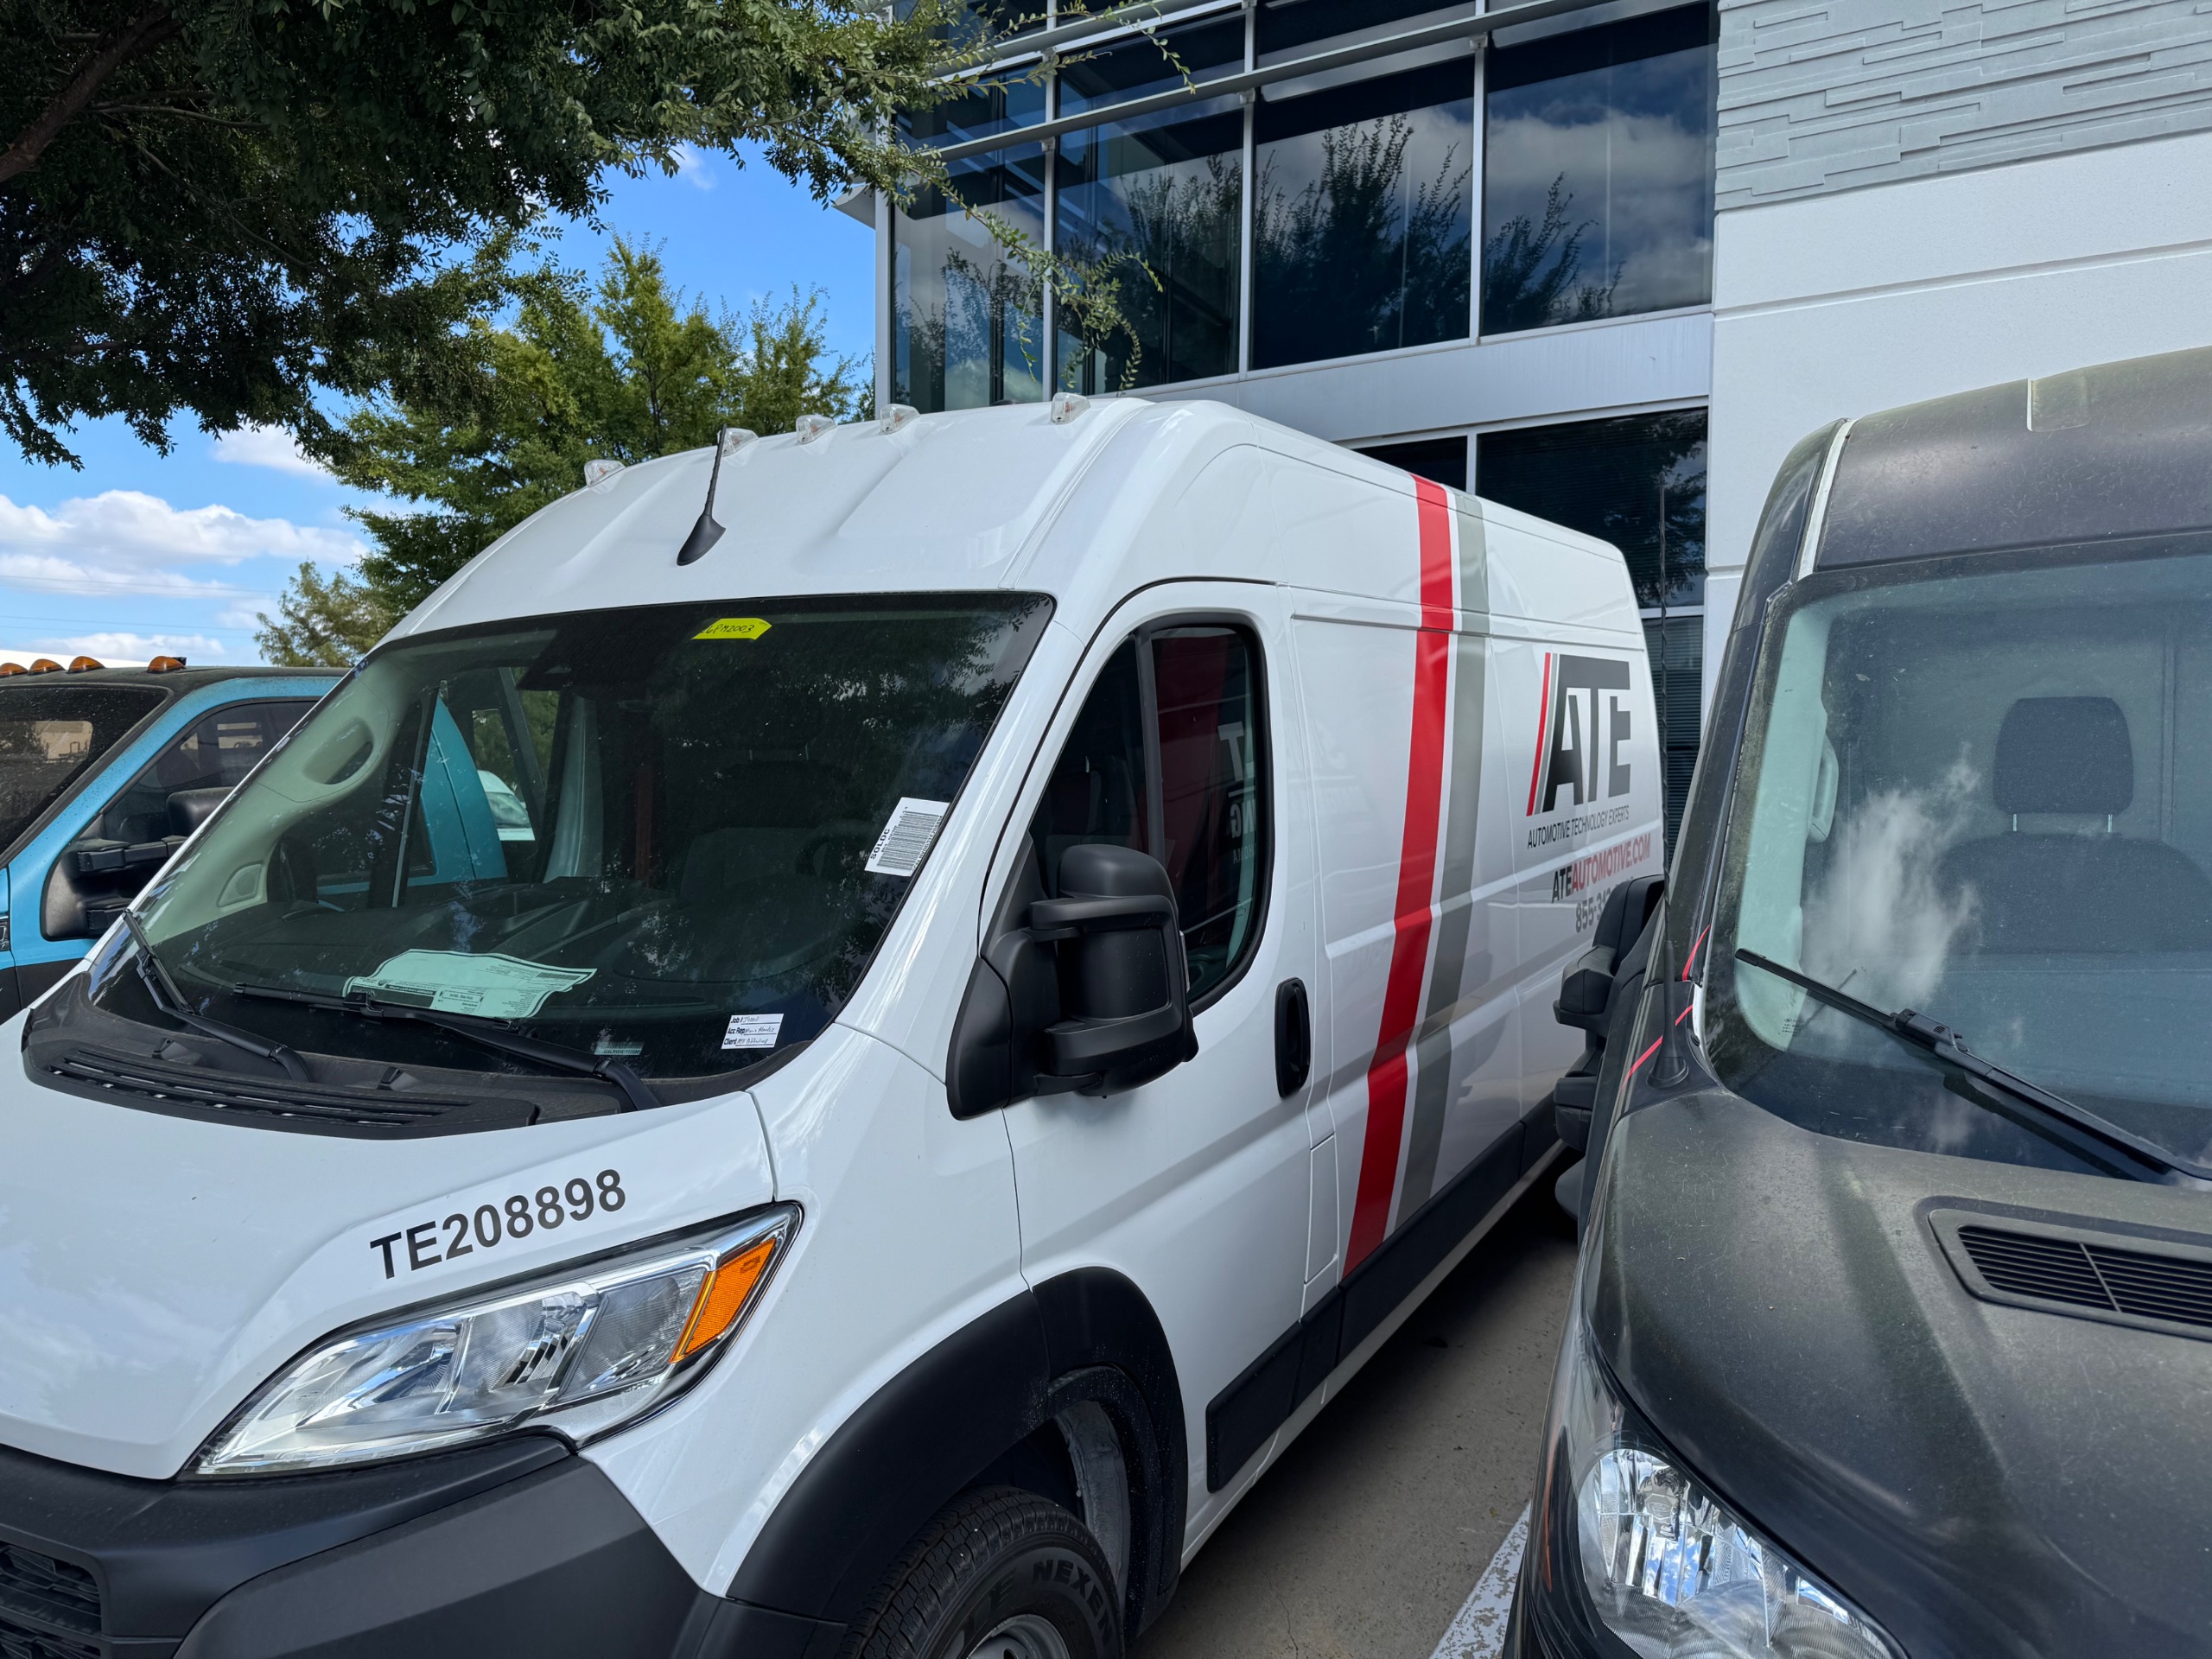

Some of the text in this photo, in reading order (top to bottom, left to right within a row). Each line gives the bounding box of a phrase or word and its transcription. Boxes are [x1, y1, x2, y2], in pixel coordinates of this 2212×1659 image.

[1542, 654, 1631, 813] ATE
[1528, 805, 1630, 849] AUTOMOTIVE TECHNOLOGY EXPERTS
[1551, 832, 1650, 904] ATEAUTOMOTIVE.COM
[370, 1169, 626, 1280] TE208898
